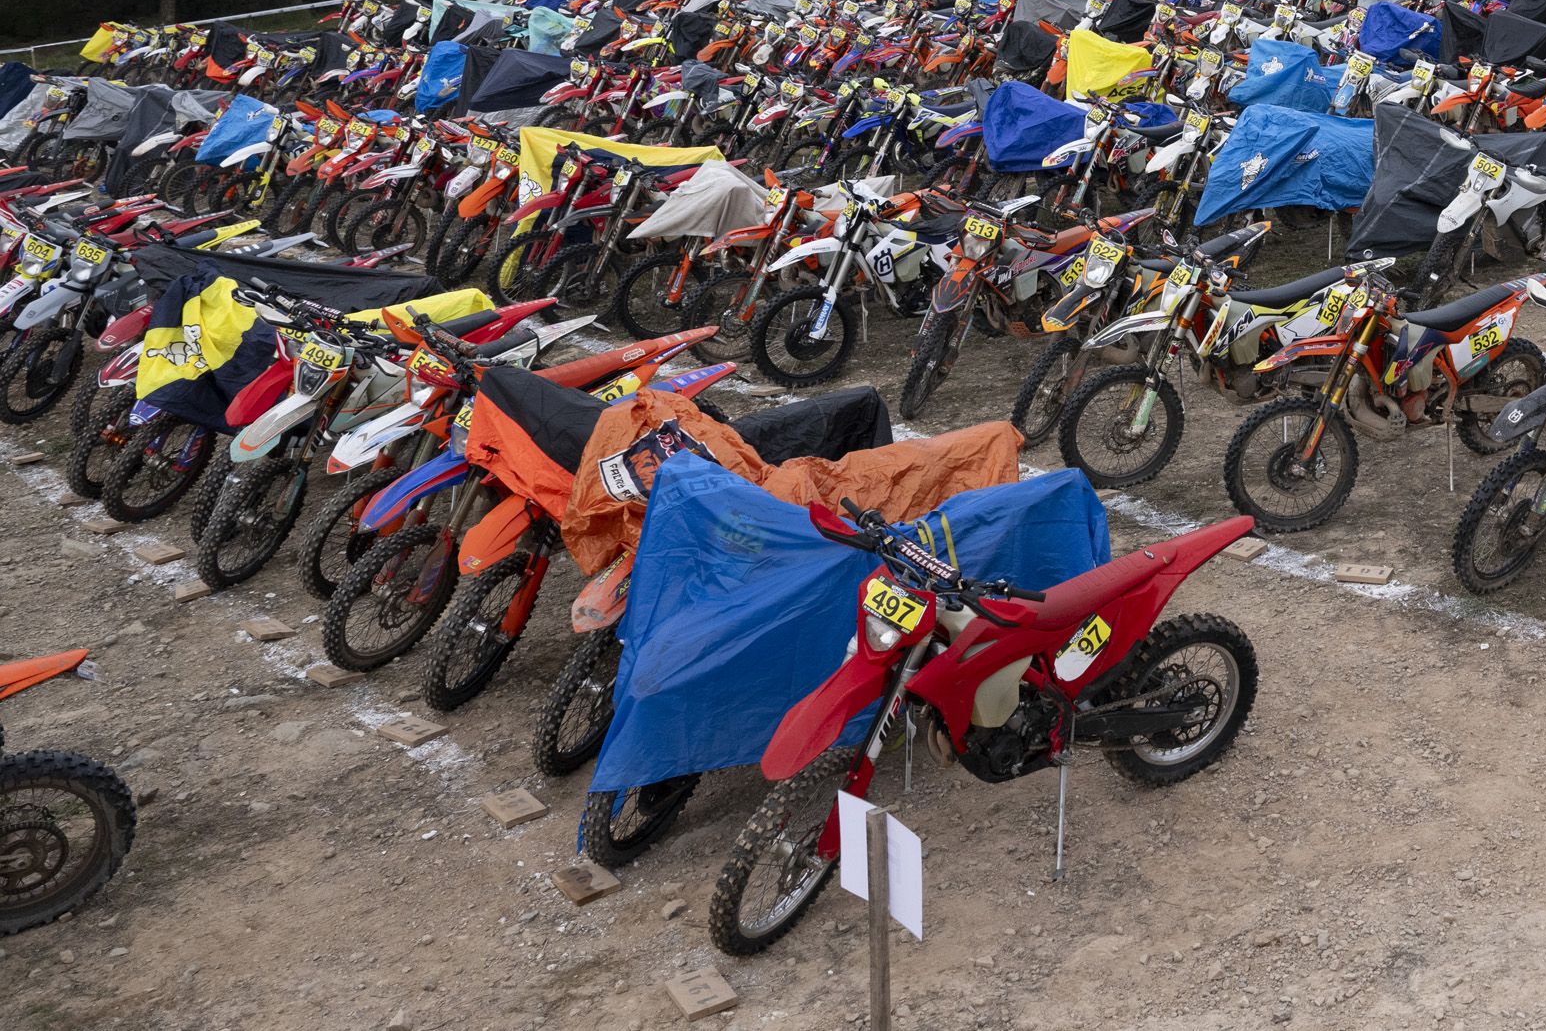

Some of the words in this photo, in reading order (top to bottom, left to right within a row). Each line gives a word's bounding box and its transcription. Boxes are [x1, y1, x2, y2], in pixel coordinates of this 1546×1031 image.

[1352, 61, 1367, 72] 332
[319, 121, 338, 133] 226
[351, 123, 369, 135] 521
[498, 149, 518, 164] 560
[1477, 158, 1498, 175] 502
[968, 220, 994, 237] 513
[26, 241, 49, 258] 604
[78, 244, 100, 261] 635
[1092, 243, 1118, 261] 622
[1064, 261, 1084, 283] 513
[1323, 294, 1344, 323] 564
[1473, 330, 1499, 352] 532
[305, 348, 335, 365] 498
[899, 544, 953, 580] RENTHAL
[871, 590, 916, 624] 497
[1072, 623, 1103, 656] 97
